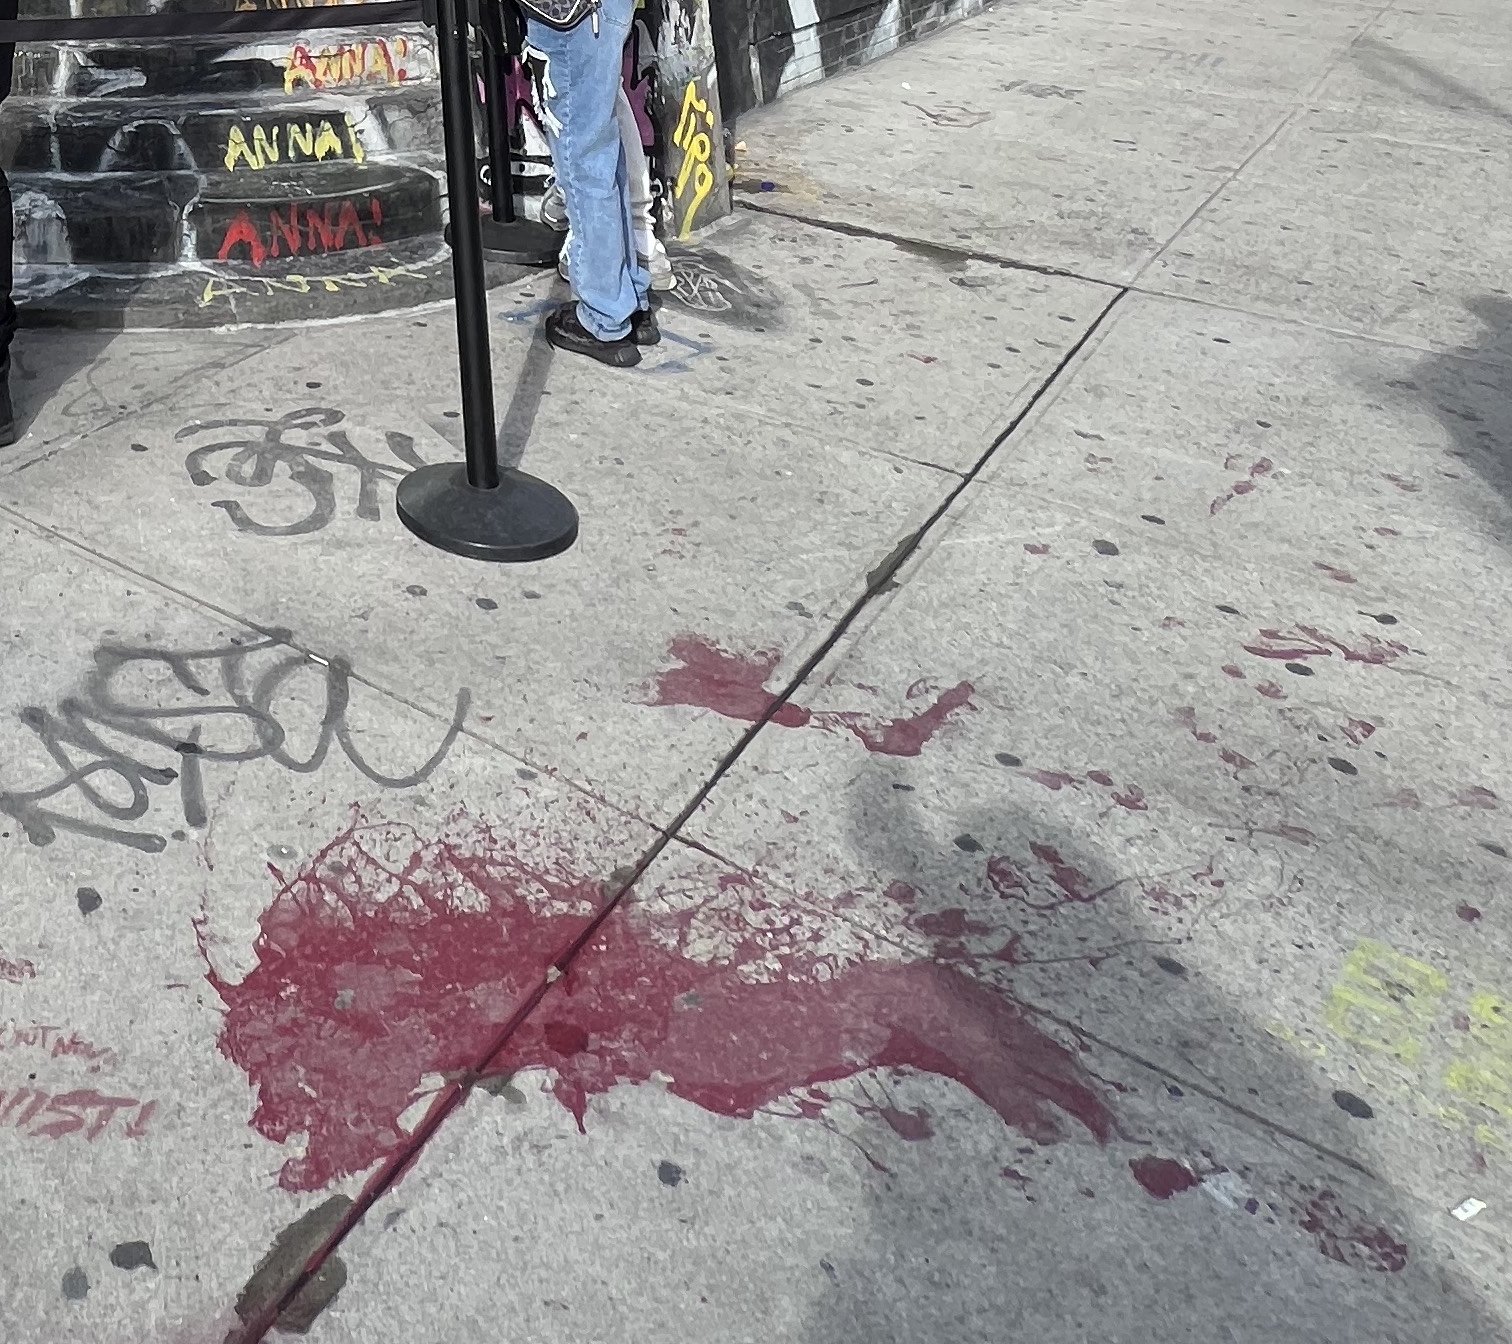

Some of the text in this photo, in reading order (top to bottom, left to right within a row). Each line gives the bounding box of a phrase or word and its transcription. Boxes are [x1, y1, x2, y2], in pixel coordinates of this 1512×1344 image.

[284, 35, 408, 95] ANNA!
[224, 112, 368, 172] ANNA!
[217, 198, 383, 268] ANNA!
